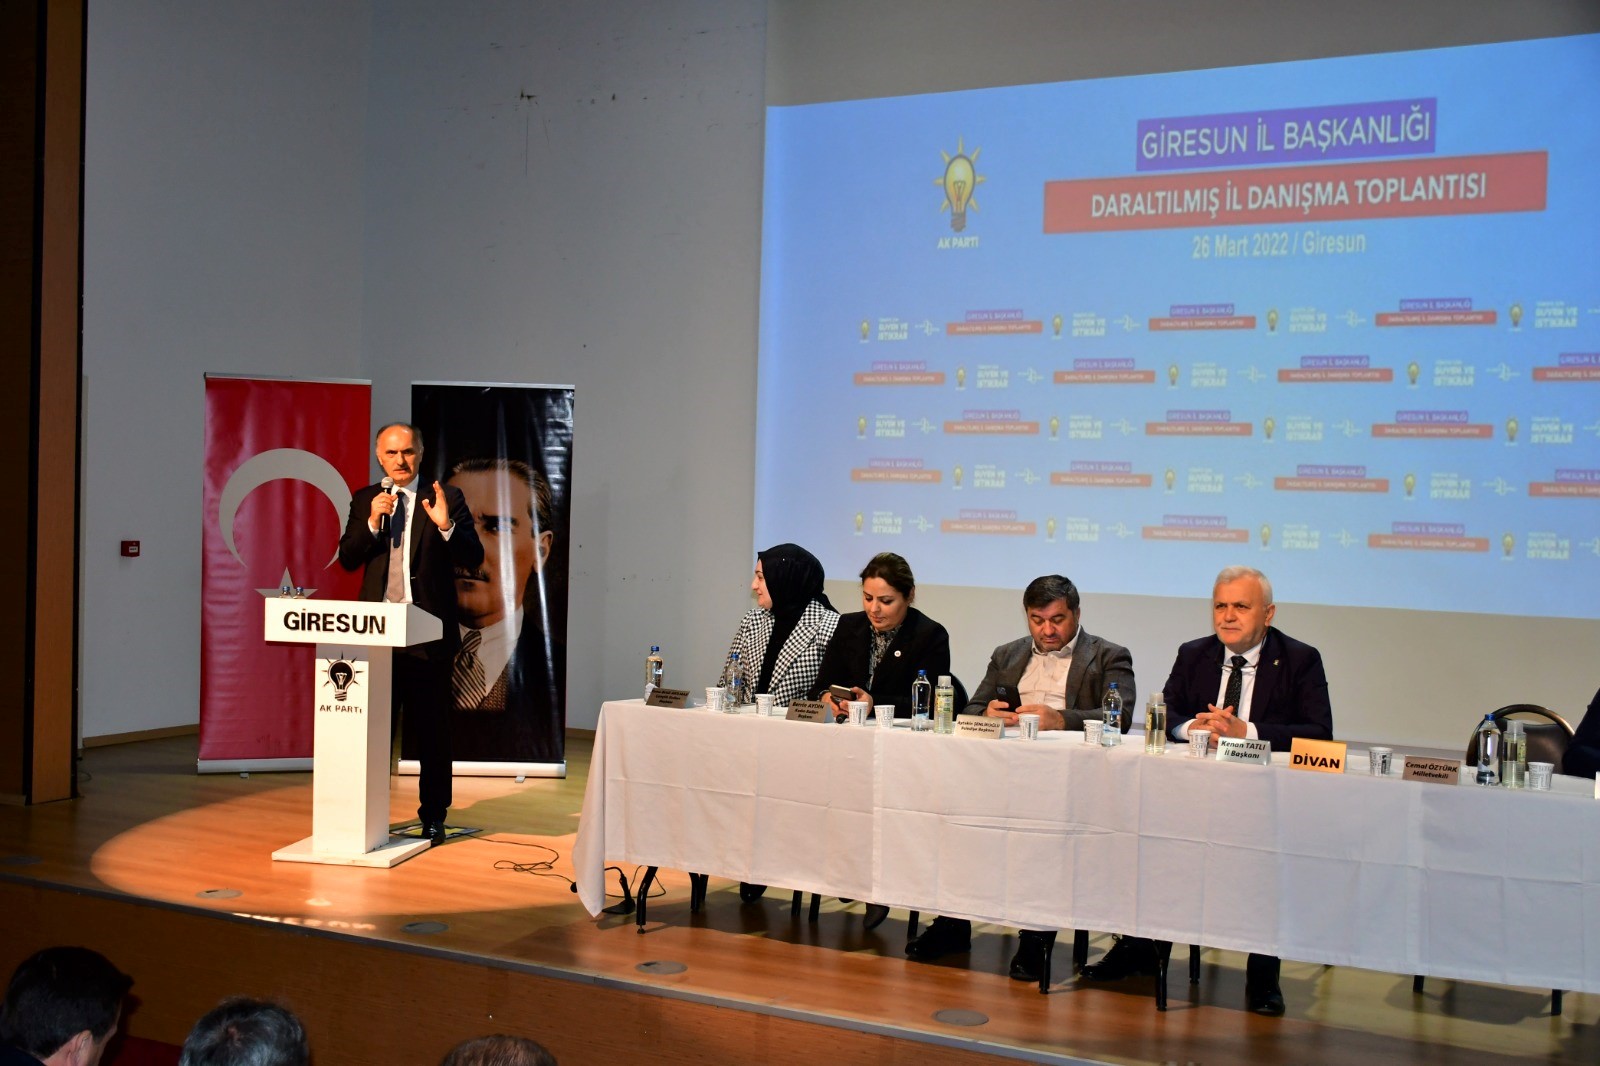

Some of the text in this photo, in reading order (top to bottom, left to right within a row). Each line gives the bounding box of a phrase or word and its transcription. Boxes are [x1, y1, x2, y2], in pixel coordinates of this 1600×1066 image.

[1142, 104, 1430, 159] GİRESUN İL BAŞKANLIĞI
[1091, 172, 1486, 219] DARALTILMIŞ İL DANIŞMA TOPLANTISI
[937, 237, 950, 248] AK
[1192, 236, 1210, 259] 26
[1215, 234, 1248, 258] Mart
[1252, 232, 1289, 256] 2022
[1302, 230, 1366, 254] Giresun
[284, 608, 386, 634] GİRESUN
[1221, 740, 1266, 750] Kenan TATLI
[1230, 750, 1260, 759] Başkanı
[1293, 752, 1340, 769] DİVAN
[1406, 761, 1458, 772] Cemal ÖZTÜRK
[1412, 770, 1448, 779] Milletvekili
